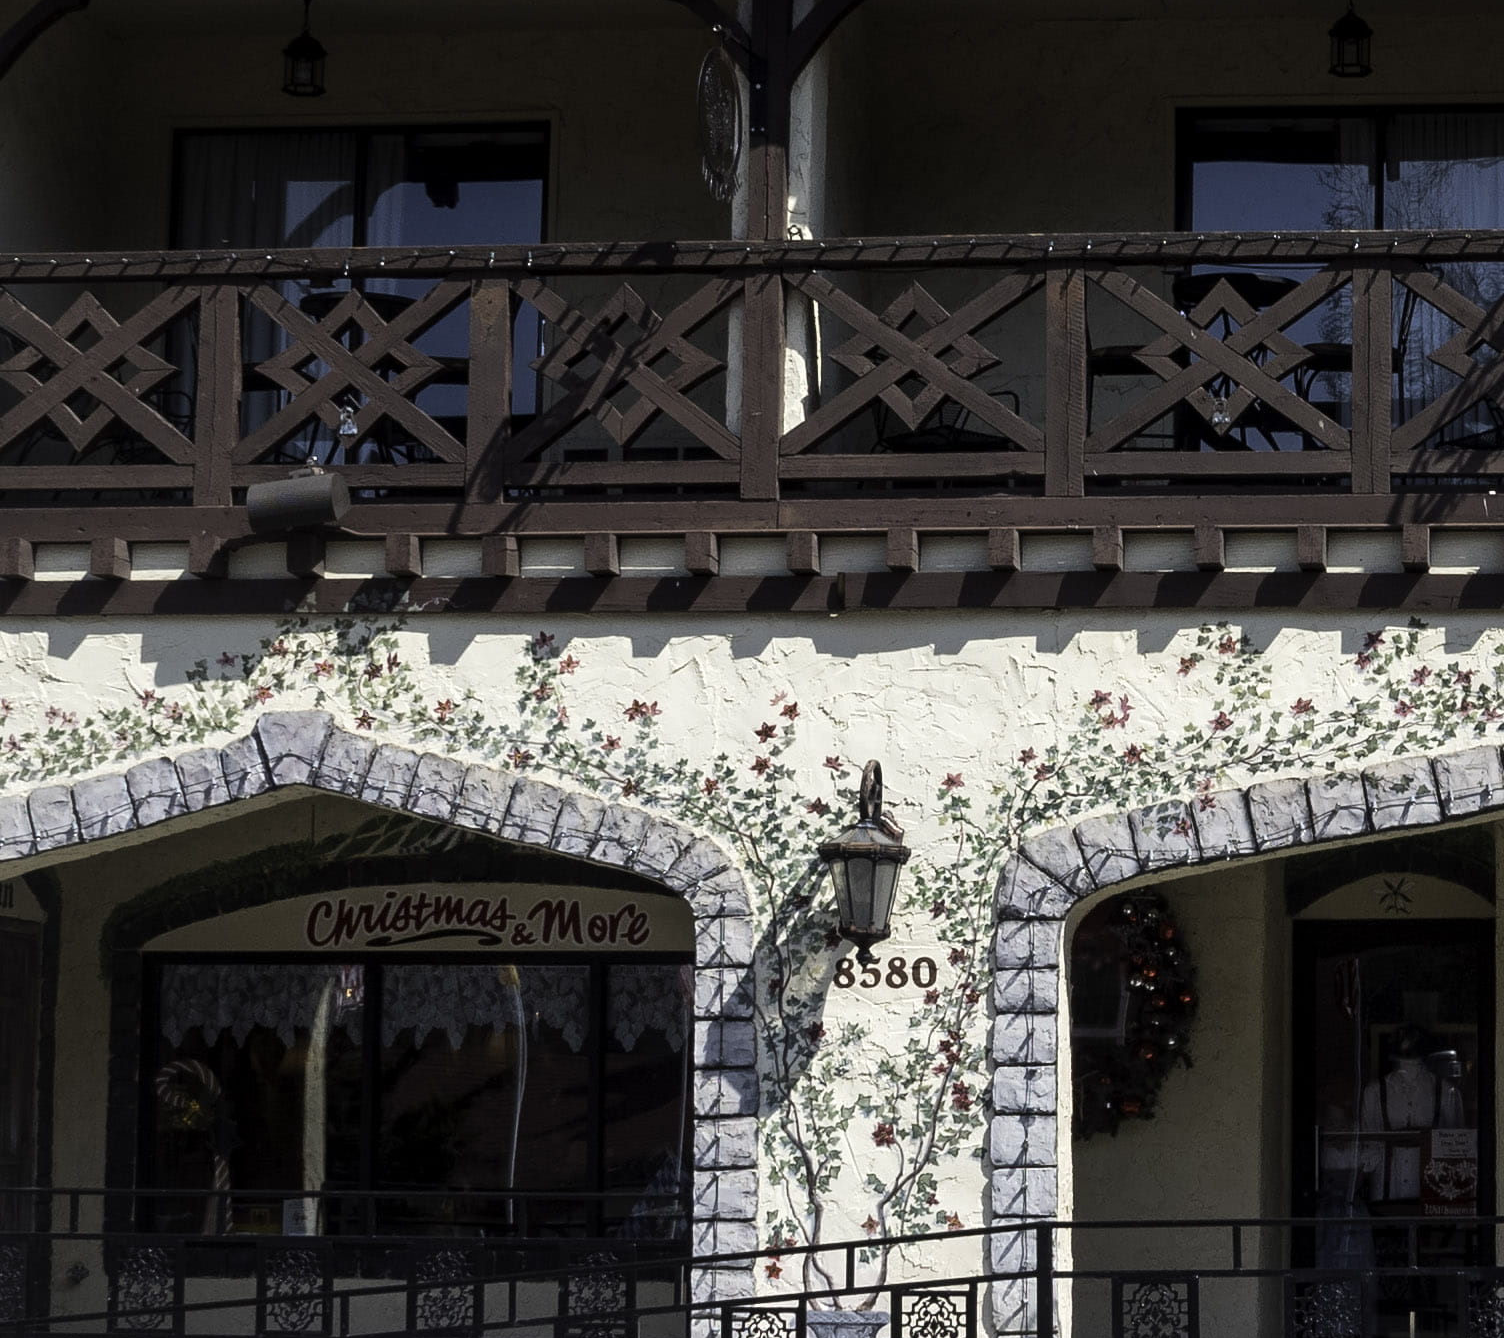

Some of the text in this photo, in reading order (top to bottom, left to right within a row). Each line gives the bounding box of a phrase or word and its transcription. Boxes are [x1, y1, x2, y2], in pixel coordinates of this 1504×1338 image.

[307, 891, 649, 946] Christmas & More
[833, 956, 937, 989] 8580
